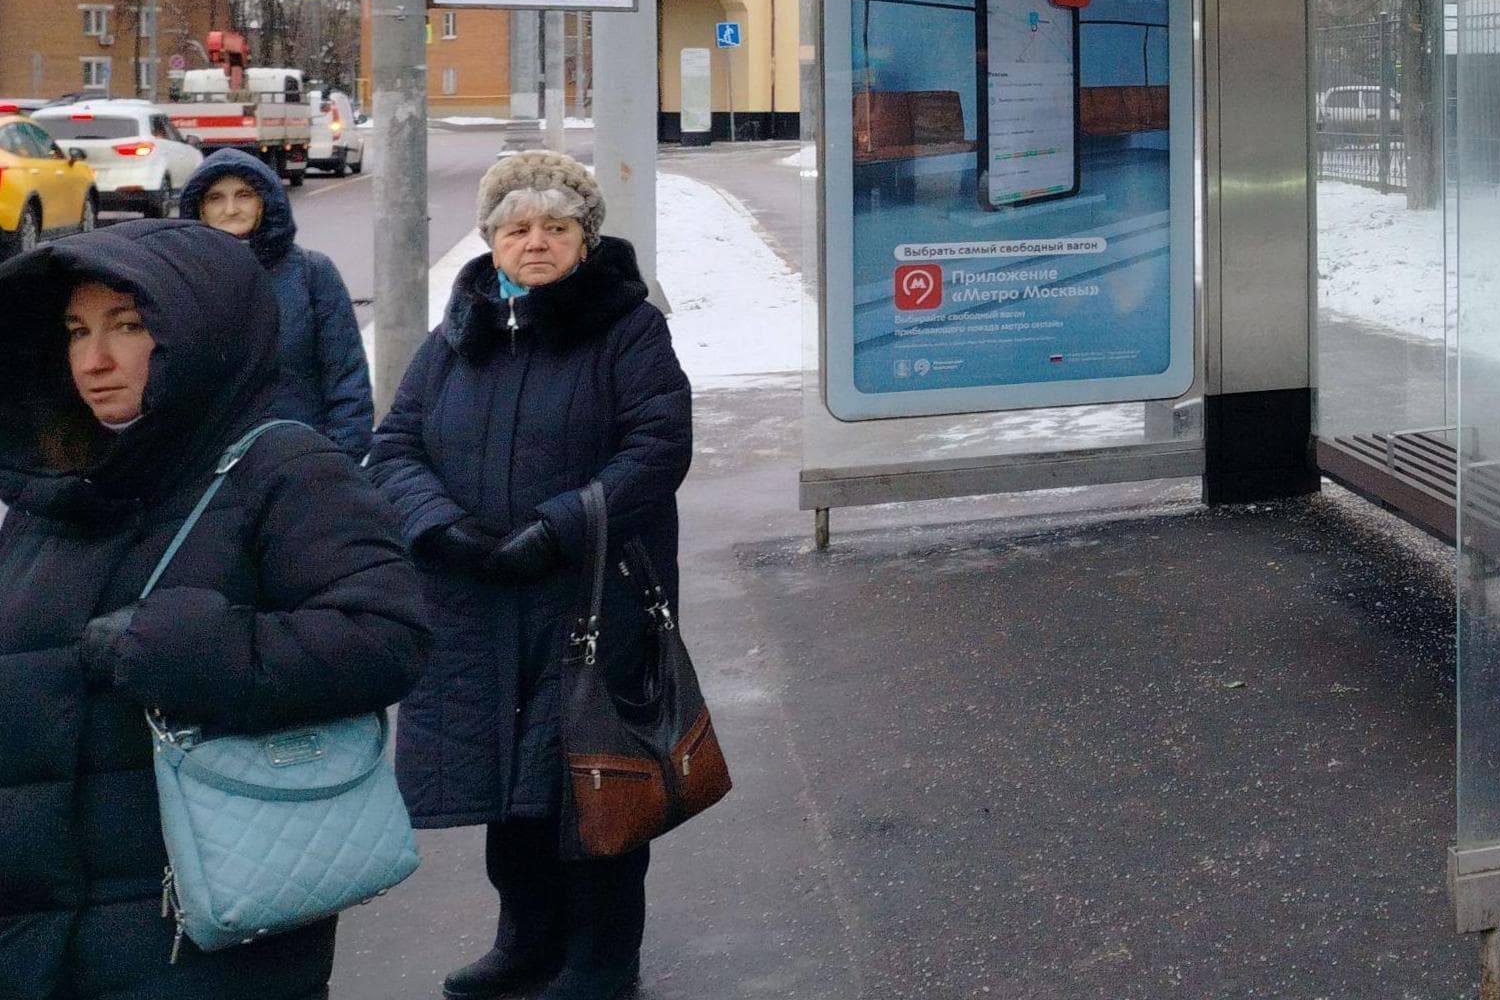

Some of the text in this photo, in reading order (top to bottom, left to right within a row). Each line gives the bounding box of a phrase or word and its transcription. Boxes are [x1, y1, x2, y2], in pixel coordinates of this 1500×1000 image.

[903, 241, 1098, 258] Выбрать самый свободный вагон
[951, 268, 1059, 285] Приложение
[951, 285, 1100, 303] «Метро Москвы»
